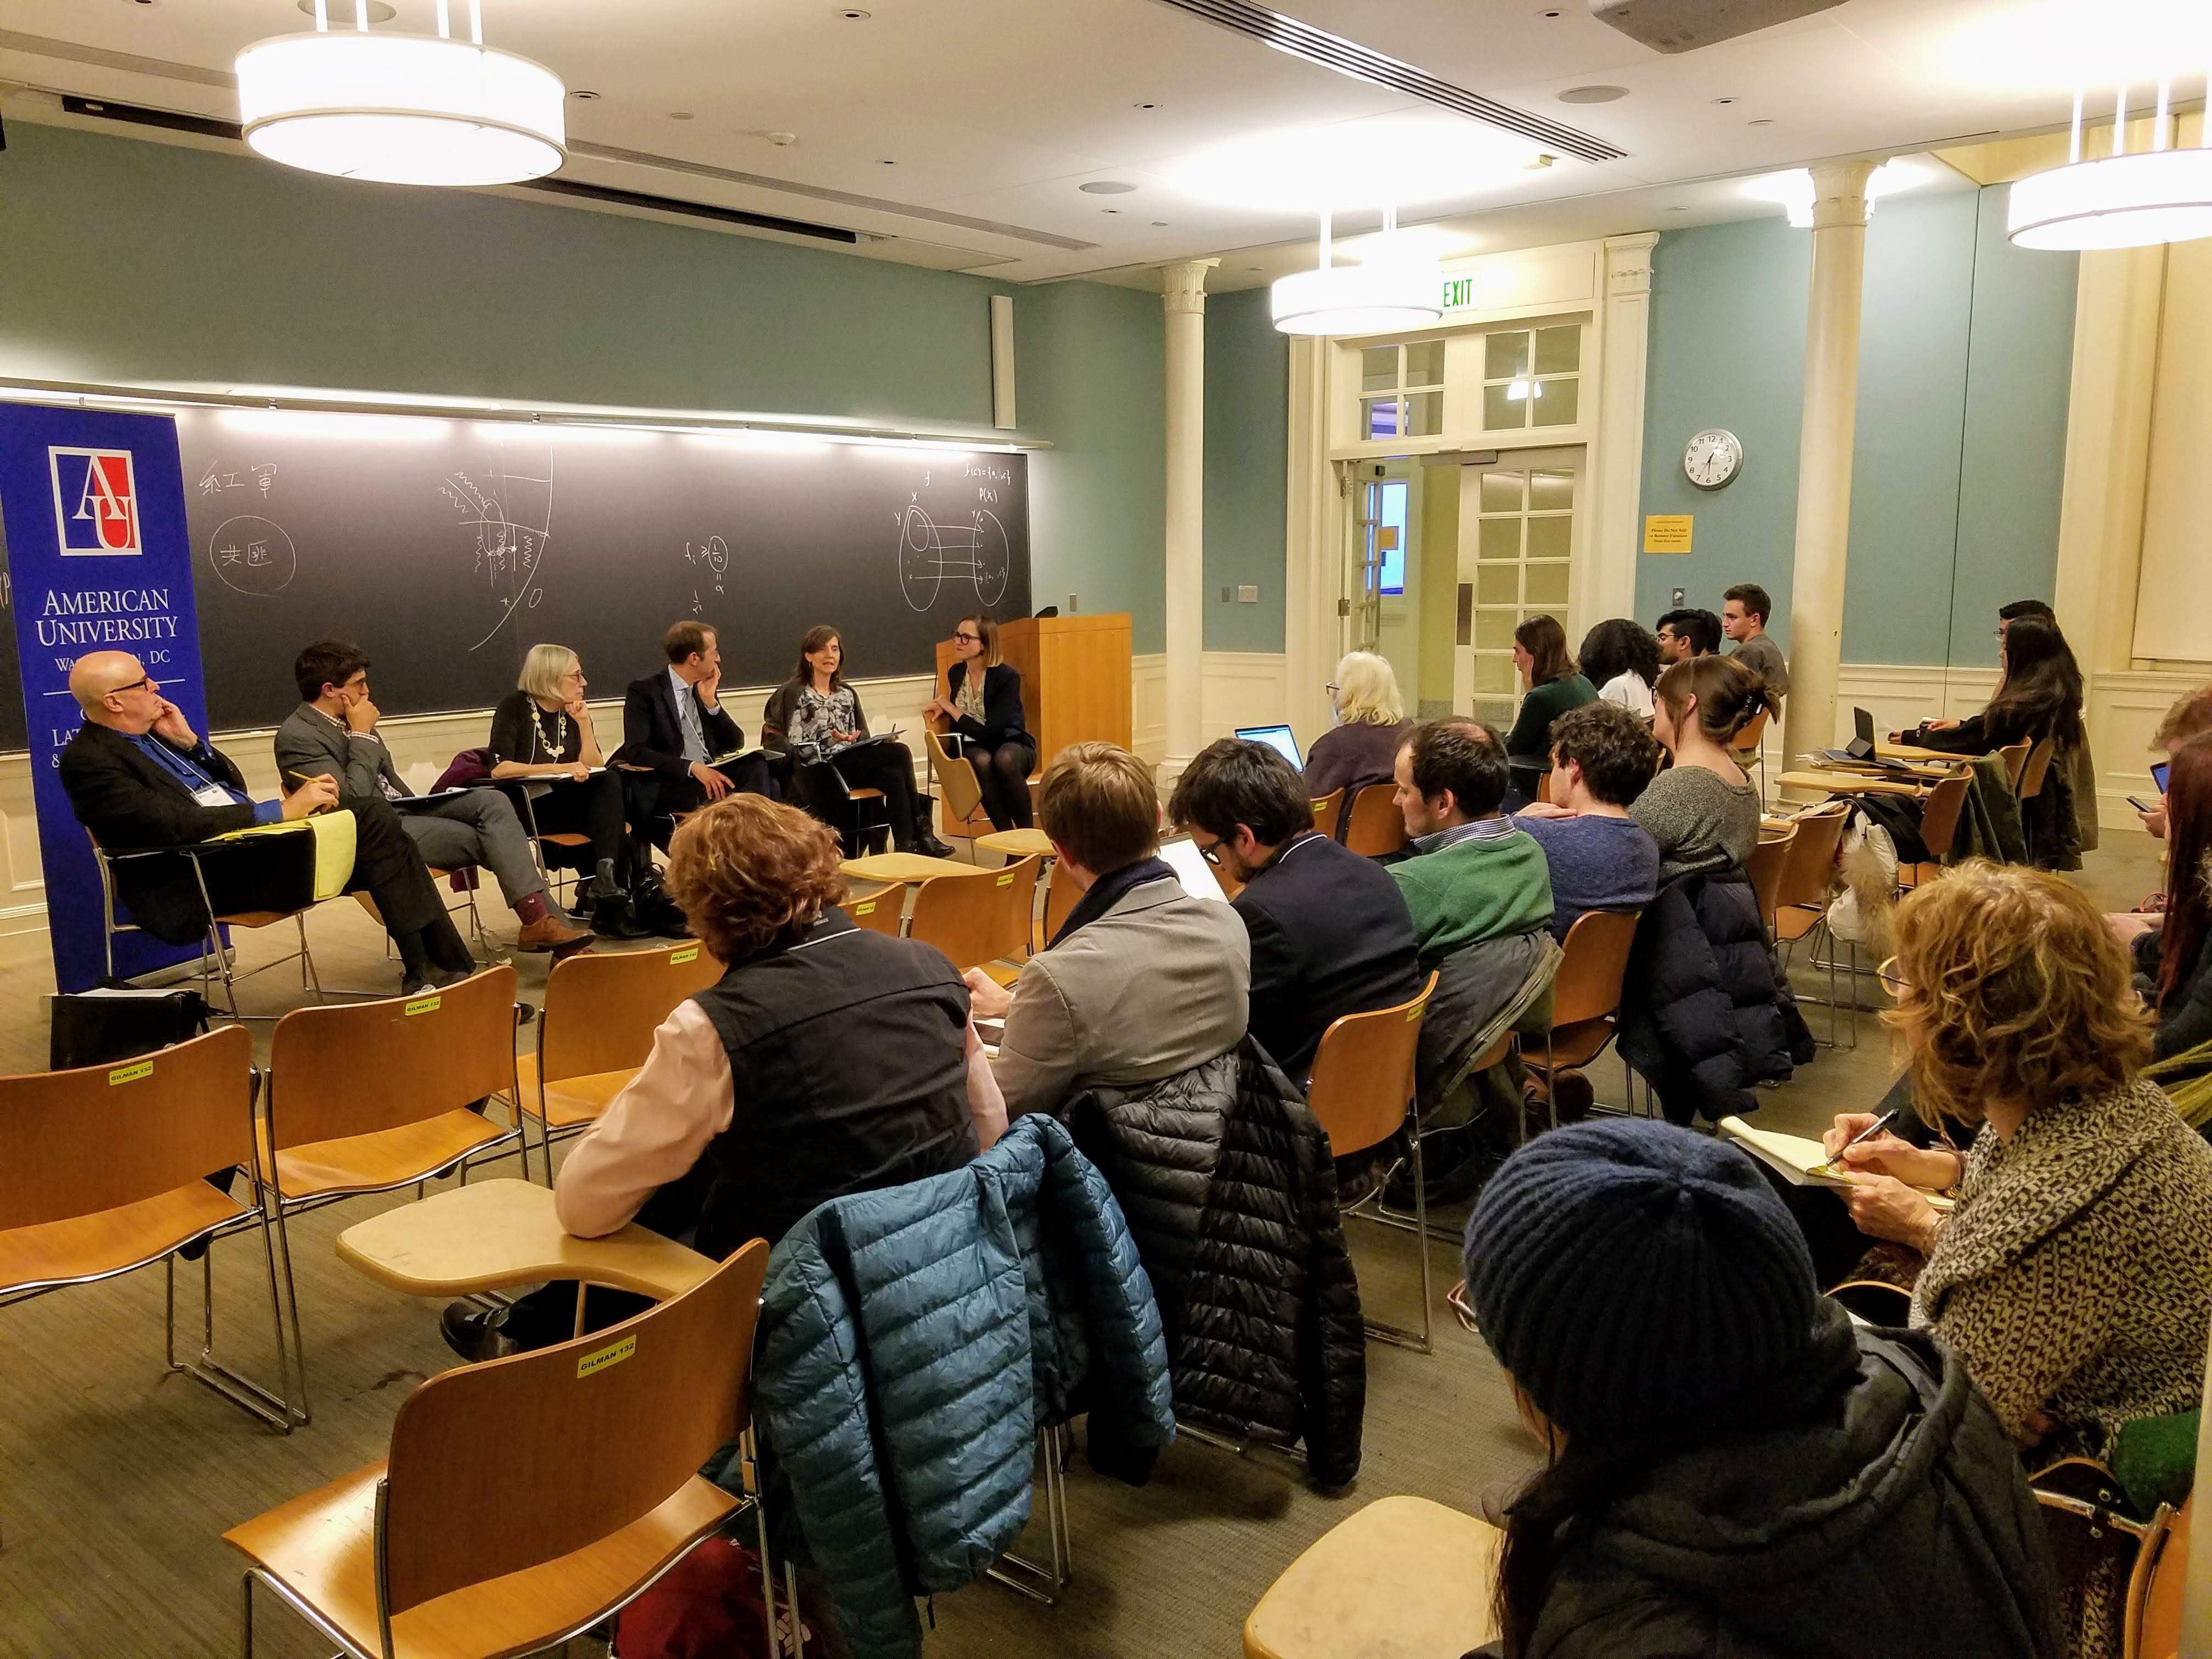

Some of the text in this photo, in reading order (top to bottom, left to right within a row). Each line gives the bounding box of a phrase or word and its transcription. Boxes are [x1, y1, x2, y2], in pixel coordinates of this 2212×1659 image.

[1443, 279, 1472, 307] EXIT
[42, 589, 169, 616] AMERICAN
[35, 616, 178, 646] UNIVERSITY
[150, 650, 170, 664] DC
[407, 1003, 428, 1012] GILMAN
[111, 1070, 138, 1081] GILMAN
[581, 1342, 634, 1370] GILMAN 132
